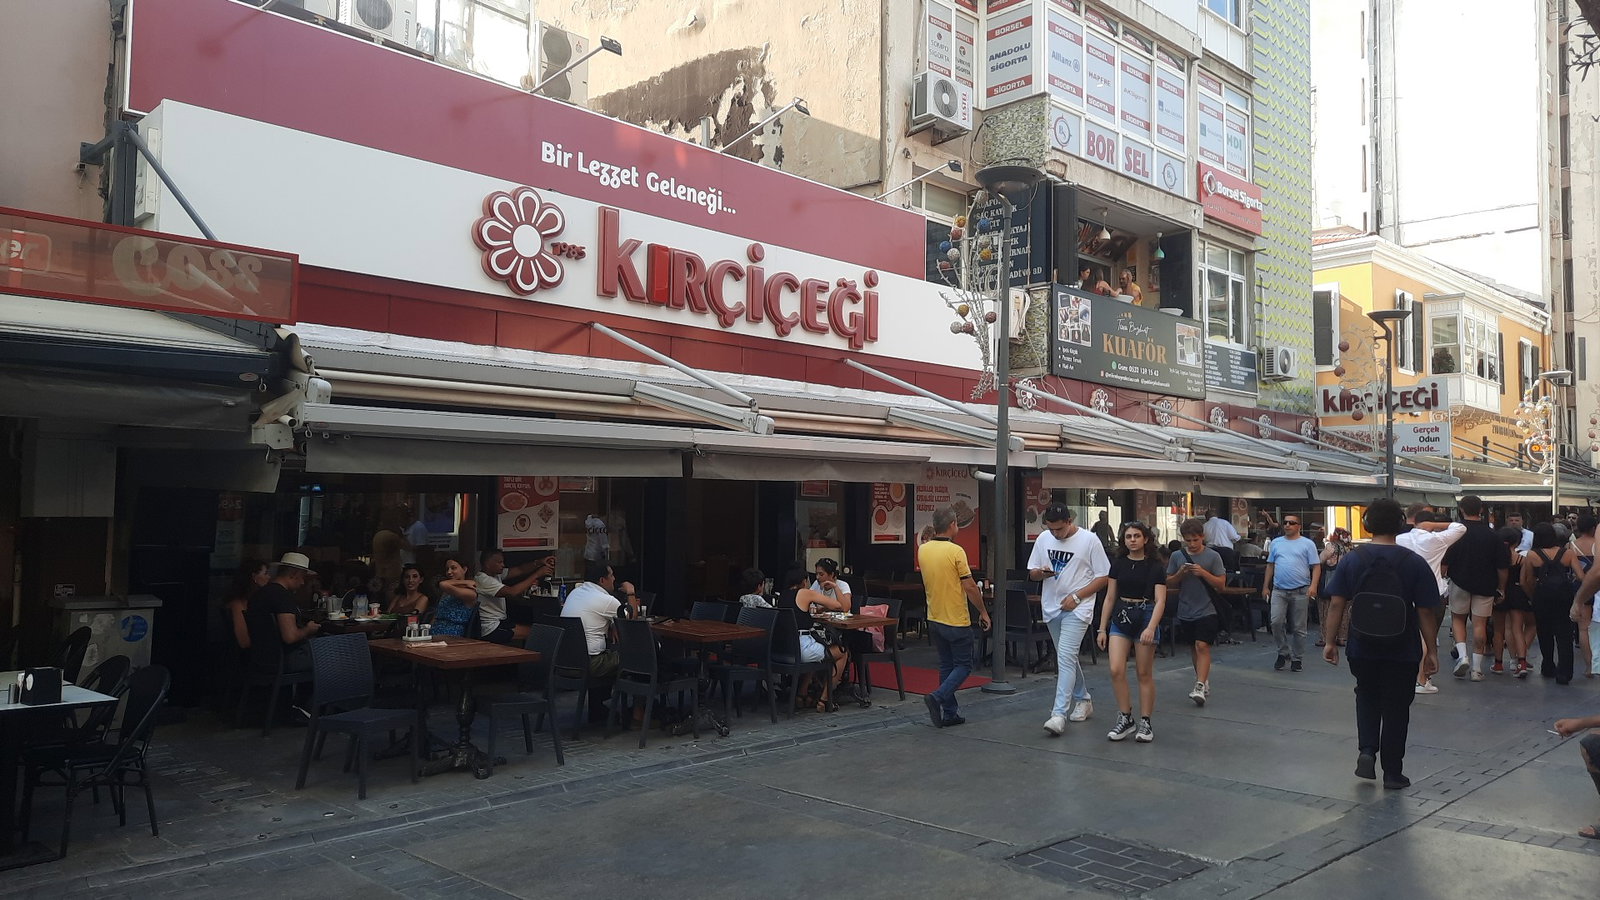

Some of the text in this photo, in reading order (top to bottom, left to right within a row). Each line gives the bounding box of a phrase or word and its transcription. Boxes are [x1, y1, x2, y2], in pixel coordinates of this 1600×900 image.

[995, 21, 1025, 37] BORSEL
[1055, 25, 1076, 42] BORSEL
[988, 42, 1031, 62] ANADOLU
[1051, 50, 1073, 67] Allianz
[990, 55, 1028, 72] SİGORTA
[993, 79, 1026, 95] SİGORTA
[1227, 132, 1242, 151] HDI
[1087, 130, 1115, 165] BOR
[1125, 146, 1150, 178] SEL
[541, 140, 573, 169] Bir
[577, 151, 640, 190] Lezzet
[1239, 190, 1263, 211] Sigorta
[550, 241, 588, 261] 1985
[1102, 332, 1168, 365] KUAFÖR
[1412, 425, 1440, 438] Gerçek
[1418, 434, 1440, 443] Odun
